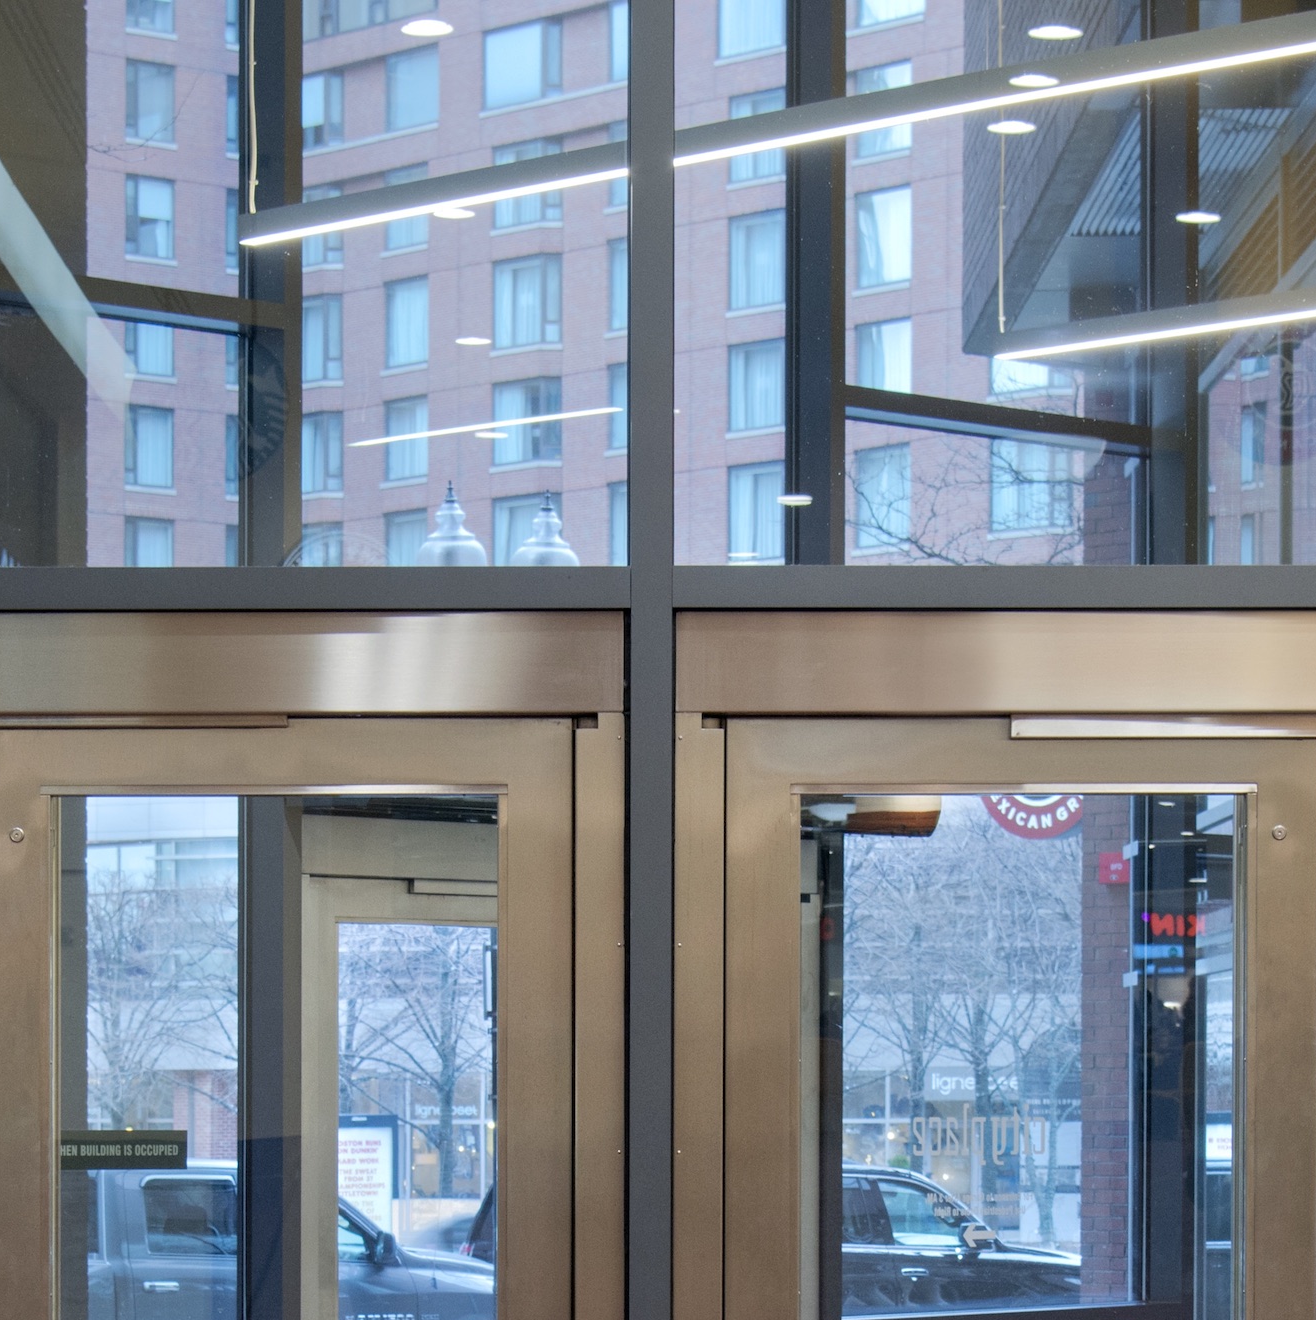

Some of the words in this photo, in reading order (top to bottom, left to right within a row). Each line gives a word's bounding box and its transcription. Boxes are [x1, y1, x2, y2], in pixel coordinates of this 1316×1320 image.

[80, 1144, 121, 1156] BUILDING
[123, 1144, 132, 1156] IS
[134, 1144, 179, 1156] OCCUPIED
